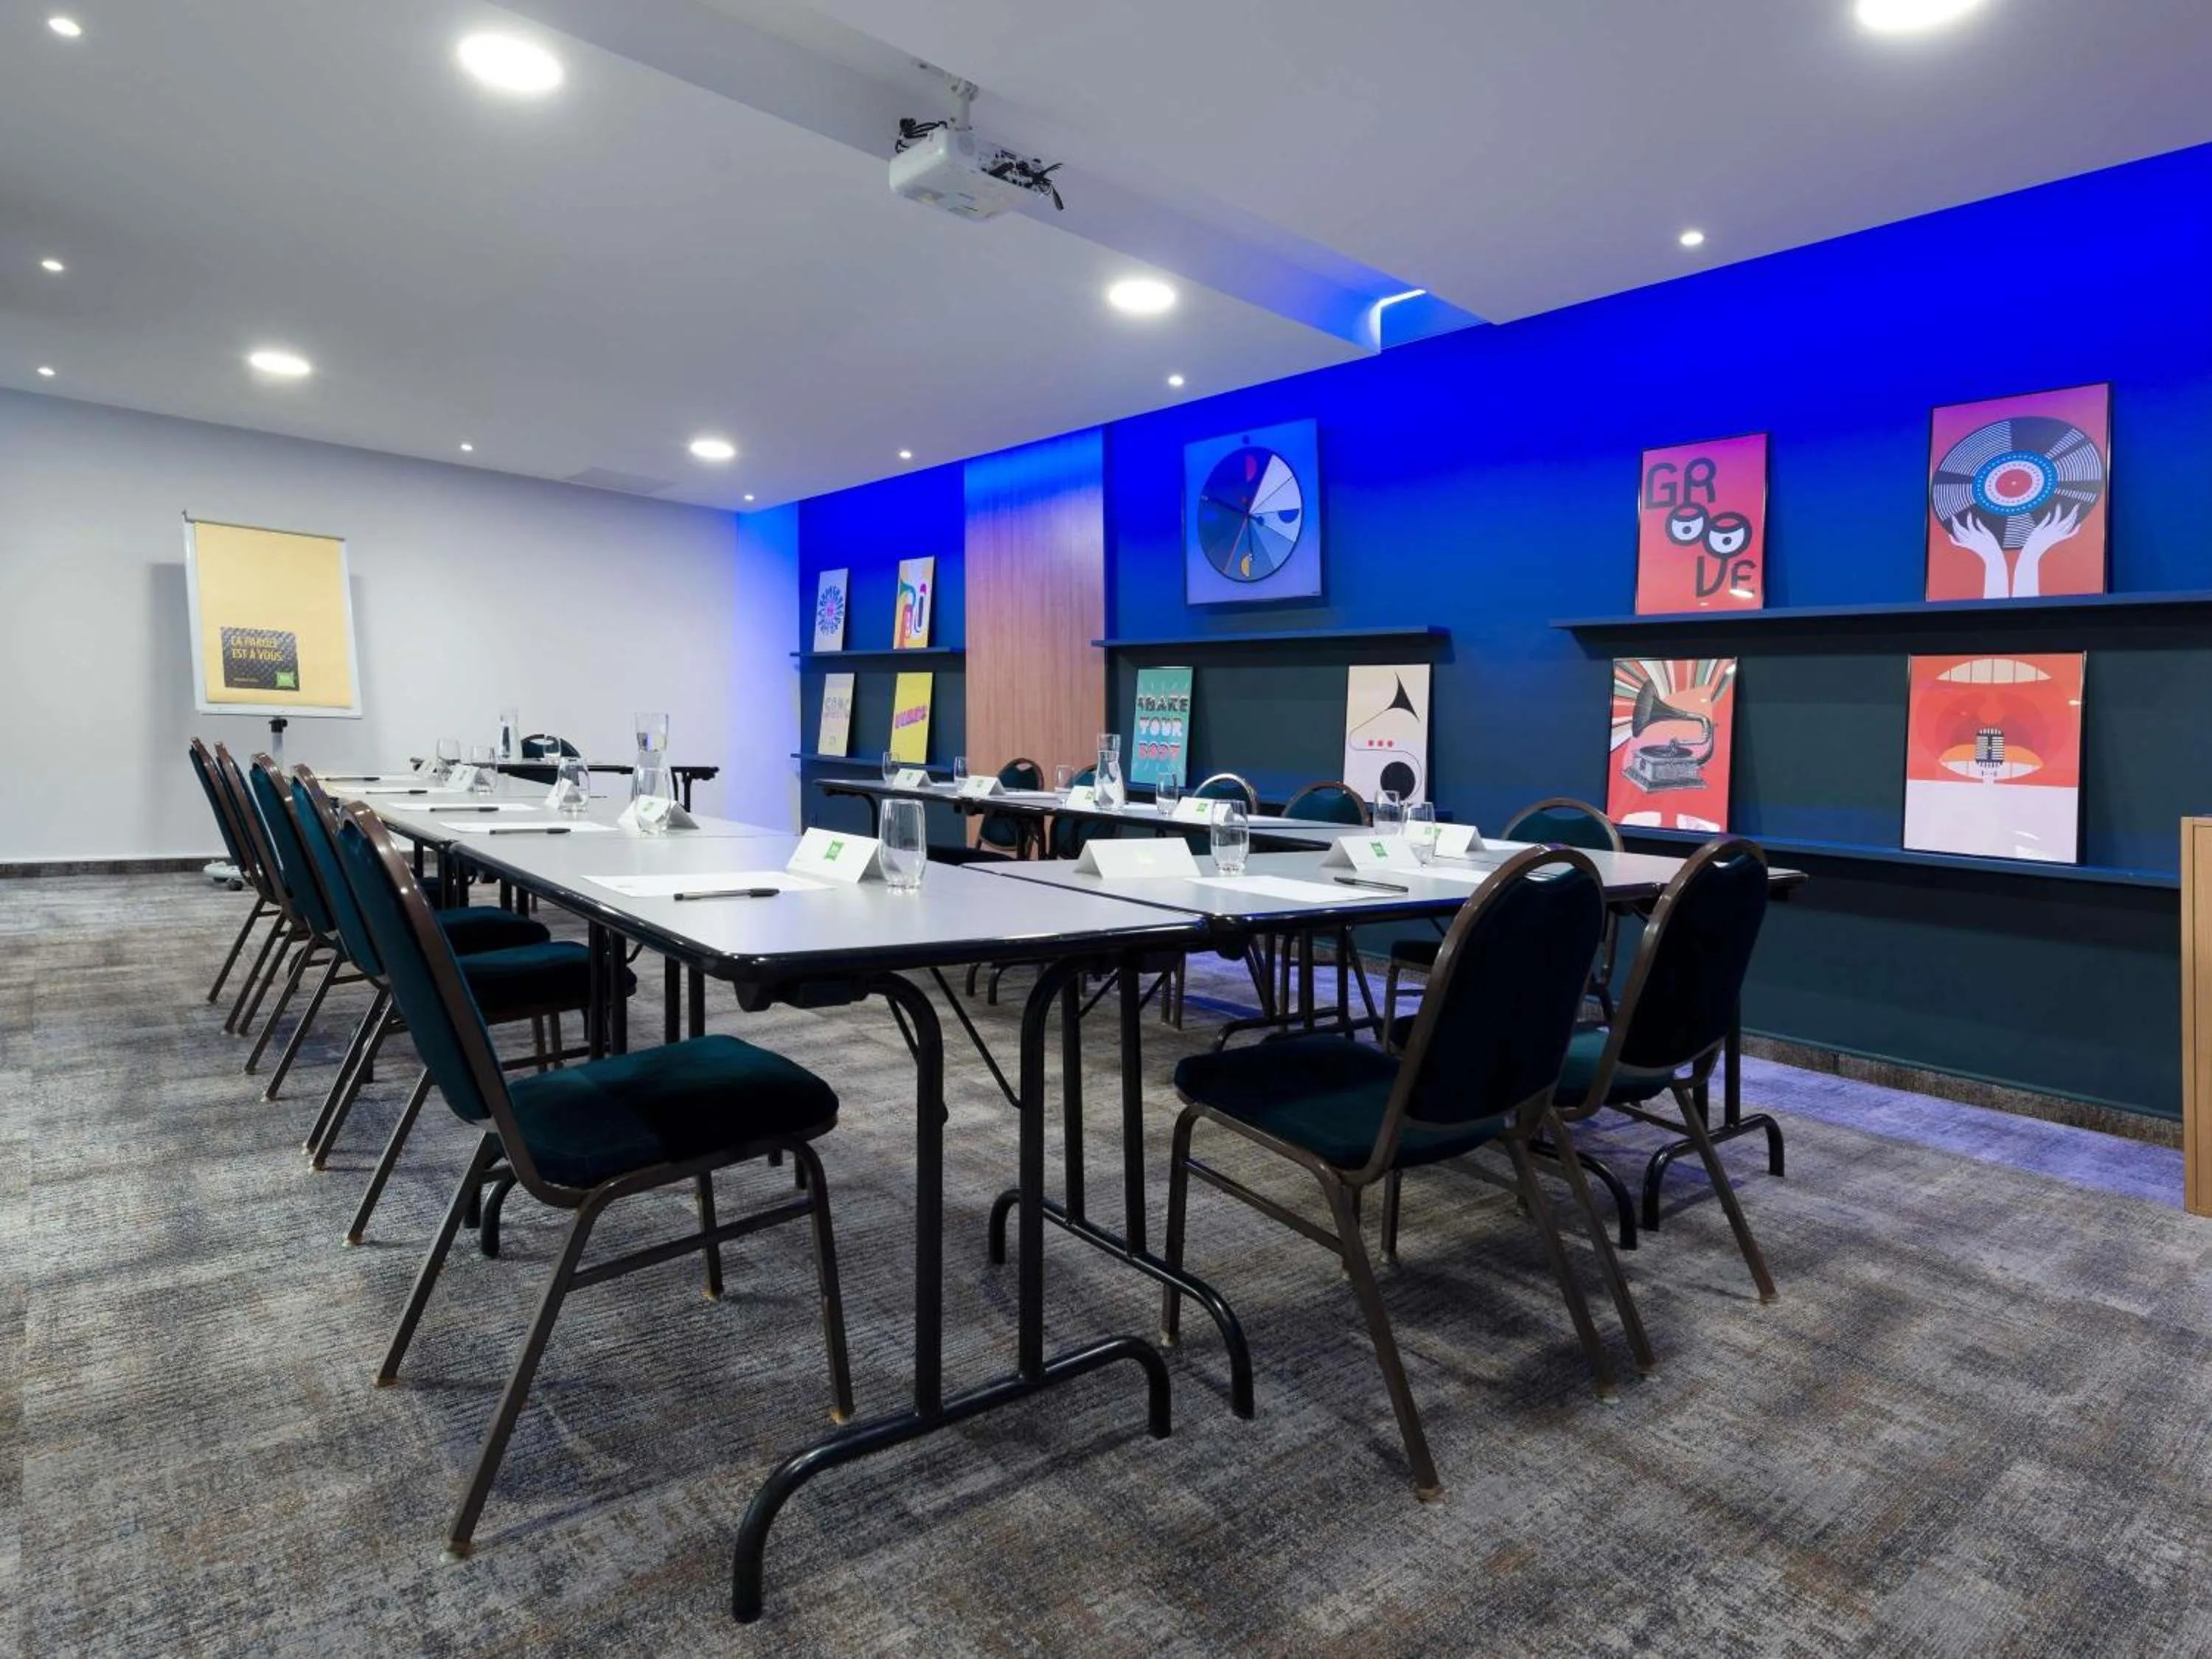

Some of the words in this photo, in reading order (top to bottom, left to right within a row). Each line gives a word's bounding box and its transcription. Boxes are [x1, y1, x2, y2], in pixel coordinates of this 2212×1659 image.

[232, 649, 248, 659] EST
[1138, 695, 1189, 712] SHAKE
[1139, 716, 1182, 737] YOUR
[1138, 740, 1180, 760] BODY
